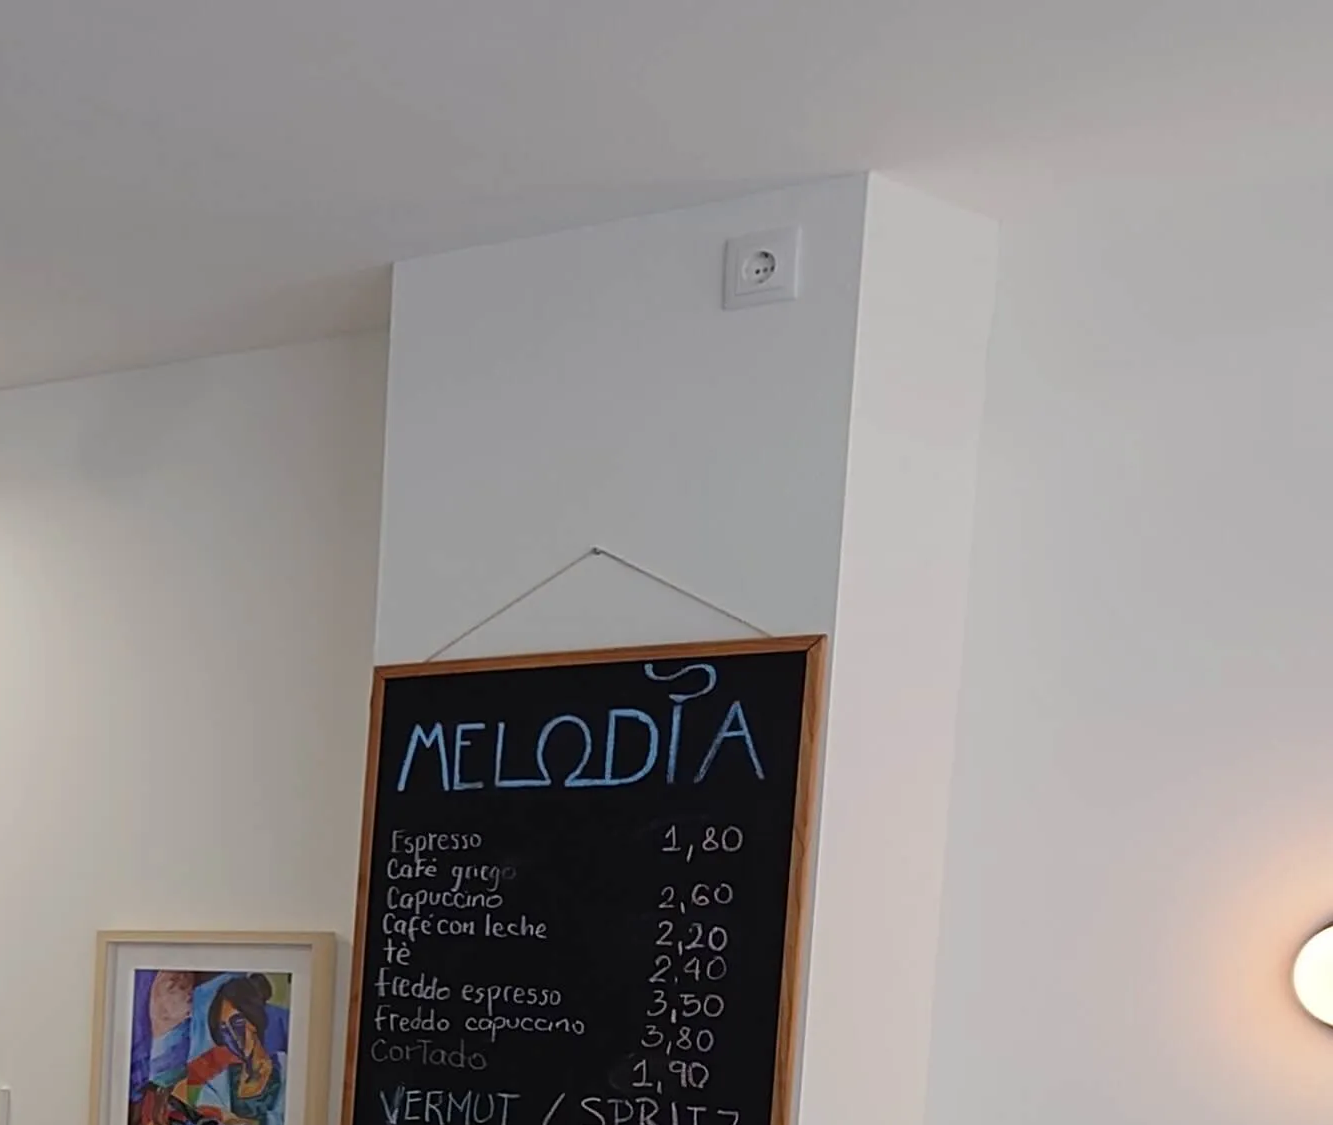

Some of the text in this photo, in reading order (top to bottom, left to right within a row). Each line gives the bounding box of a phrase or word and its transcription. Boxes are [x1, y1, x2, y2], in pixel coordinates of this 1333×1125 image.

[391, 825, 743, 863] Espresso 1,80
[387, 883, 733, 915] Capuccino 2,60
[436, 918, 475, 935] con
[485, 913, 548, 939] leche
[655, 920, 728, 956] 2,20
[461, 983, 562, 1017] espresso
[647, 990, 724, 1024] 3,50
[641, 1025, 714, 1055] 3,80
[632, 1060, 709, 1094] 1,90
